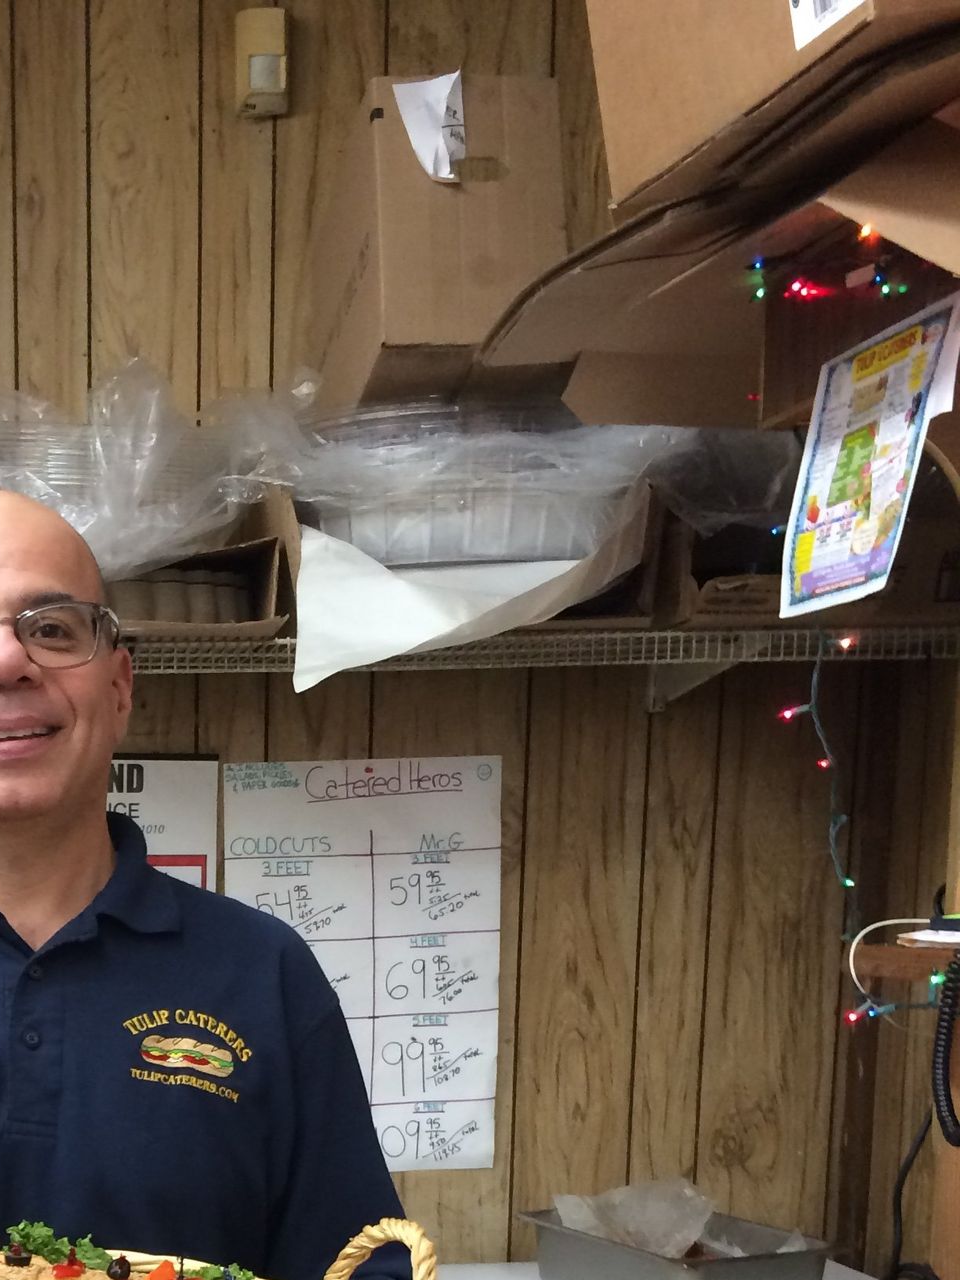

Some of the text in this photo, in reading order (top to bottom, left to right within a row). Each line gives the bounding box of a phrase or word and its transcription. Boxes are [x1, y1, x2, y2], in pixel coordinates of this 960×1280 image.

[408, 759, 463, 791] Heros
[263, 860, 313, 875] 3 FEET
[389, 873, 421, 906] 59
[385, 954, 450, 1000] 69 95
[122, 1008, 253, 1062] TULIP CATERERS
[129, 1067, 240, 1104] TULIPCATERERS.COM
[381, 1037, 444, 1097] 99 95
[380, 1117, 441, 1161] 09 95
